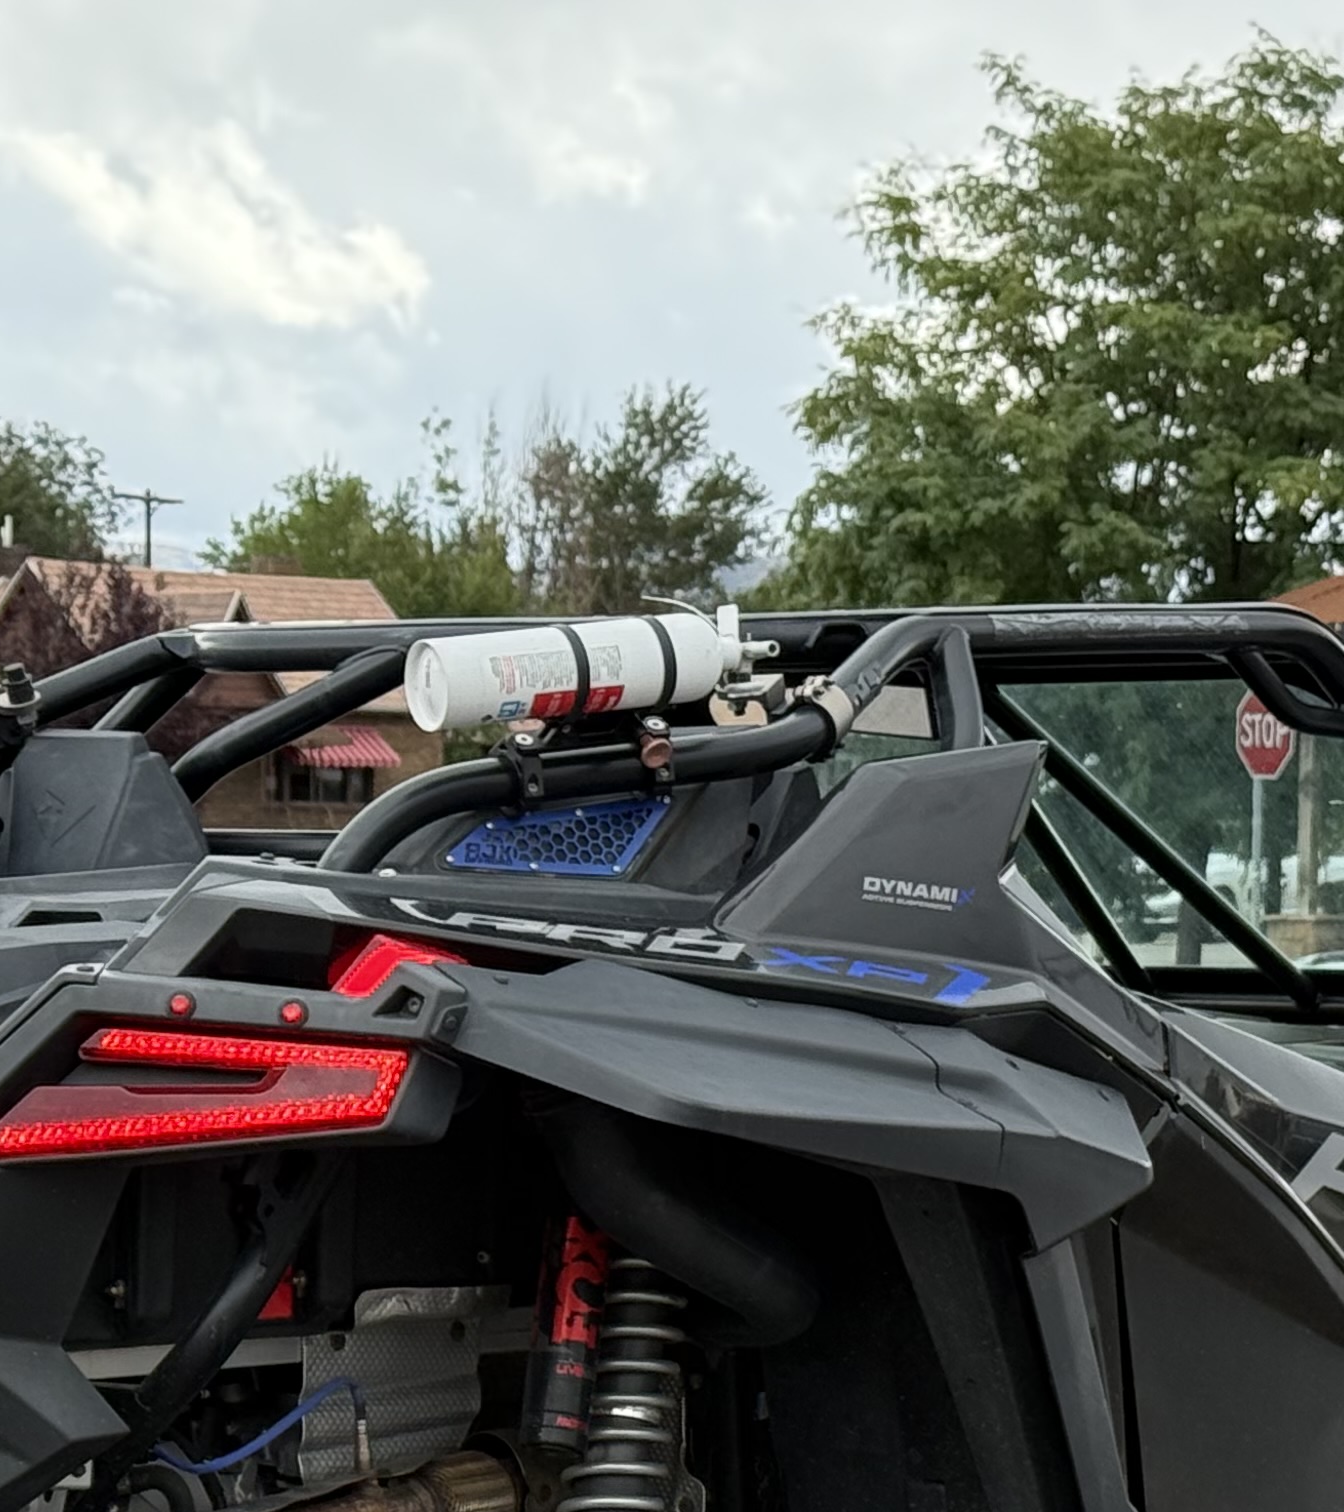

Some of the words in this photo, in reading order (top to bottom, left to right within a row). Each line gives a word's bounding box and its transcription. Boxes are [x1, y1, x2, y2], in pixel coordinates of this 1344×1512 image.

[1240, 711, 1291, 748] STOP
[862, 876, 976, 908] DYNAMIX
[442, 911, 747, 961] PRO
